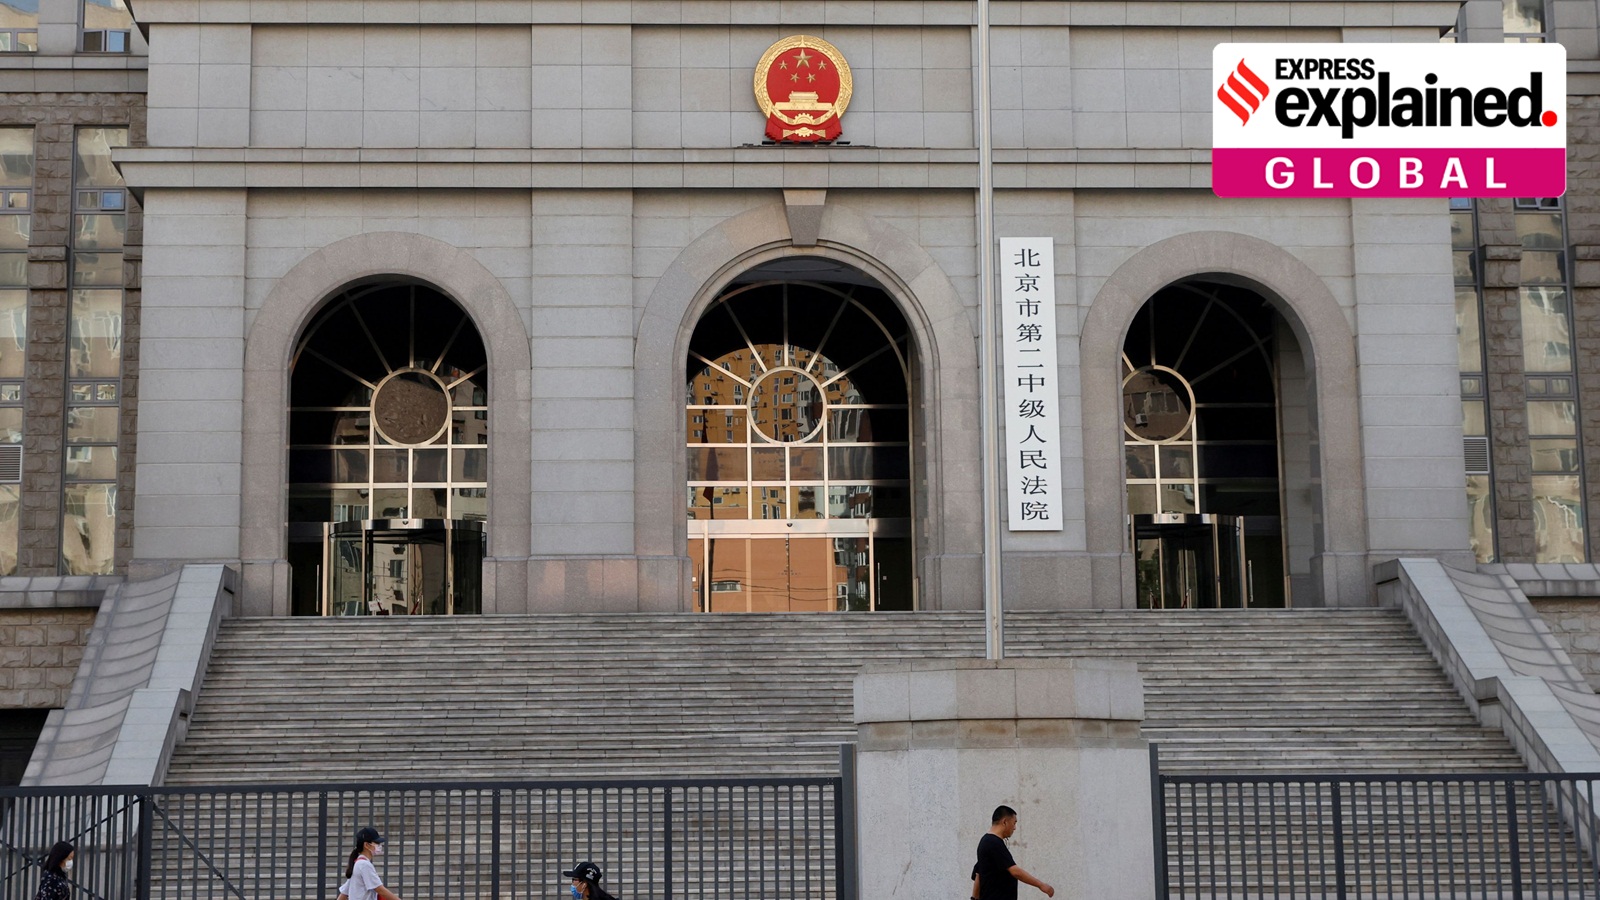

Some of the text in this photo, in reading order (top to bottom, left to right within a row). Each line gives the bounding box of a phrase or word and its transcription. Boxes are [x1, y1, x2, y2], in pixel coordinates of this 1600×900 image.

[1014, 248, 1049, 521] 北京市第二中级人民法院
